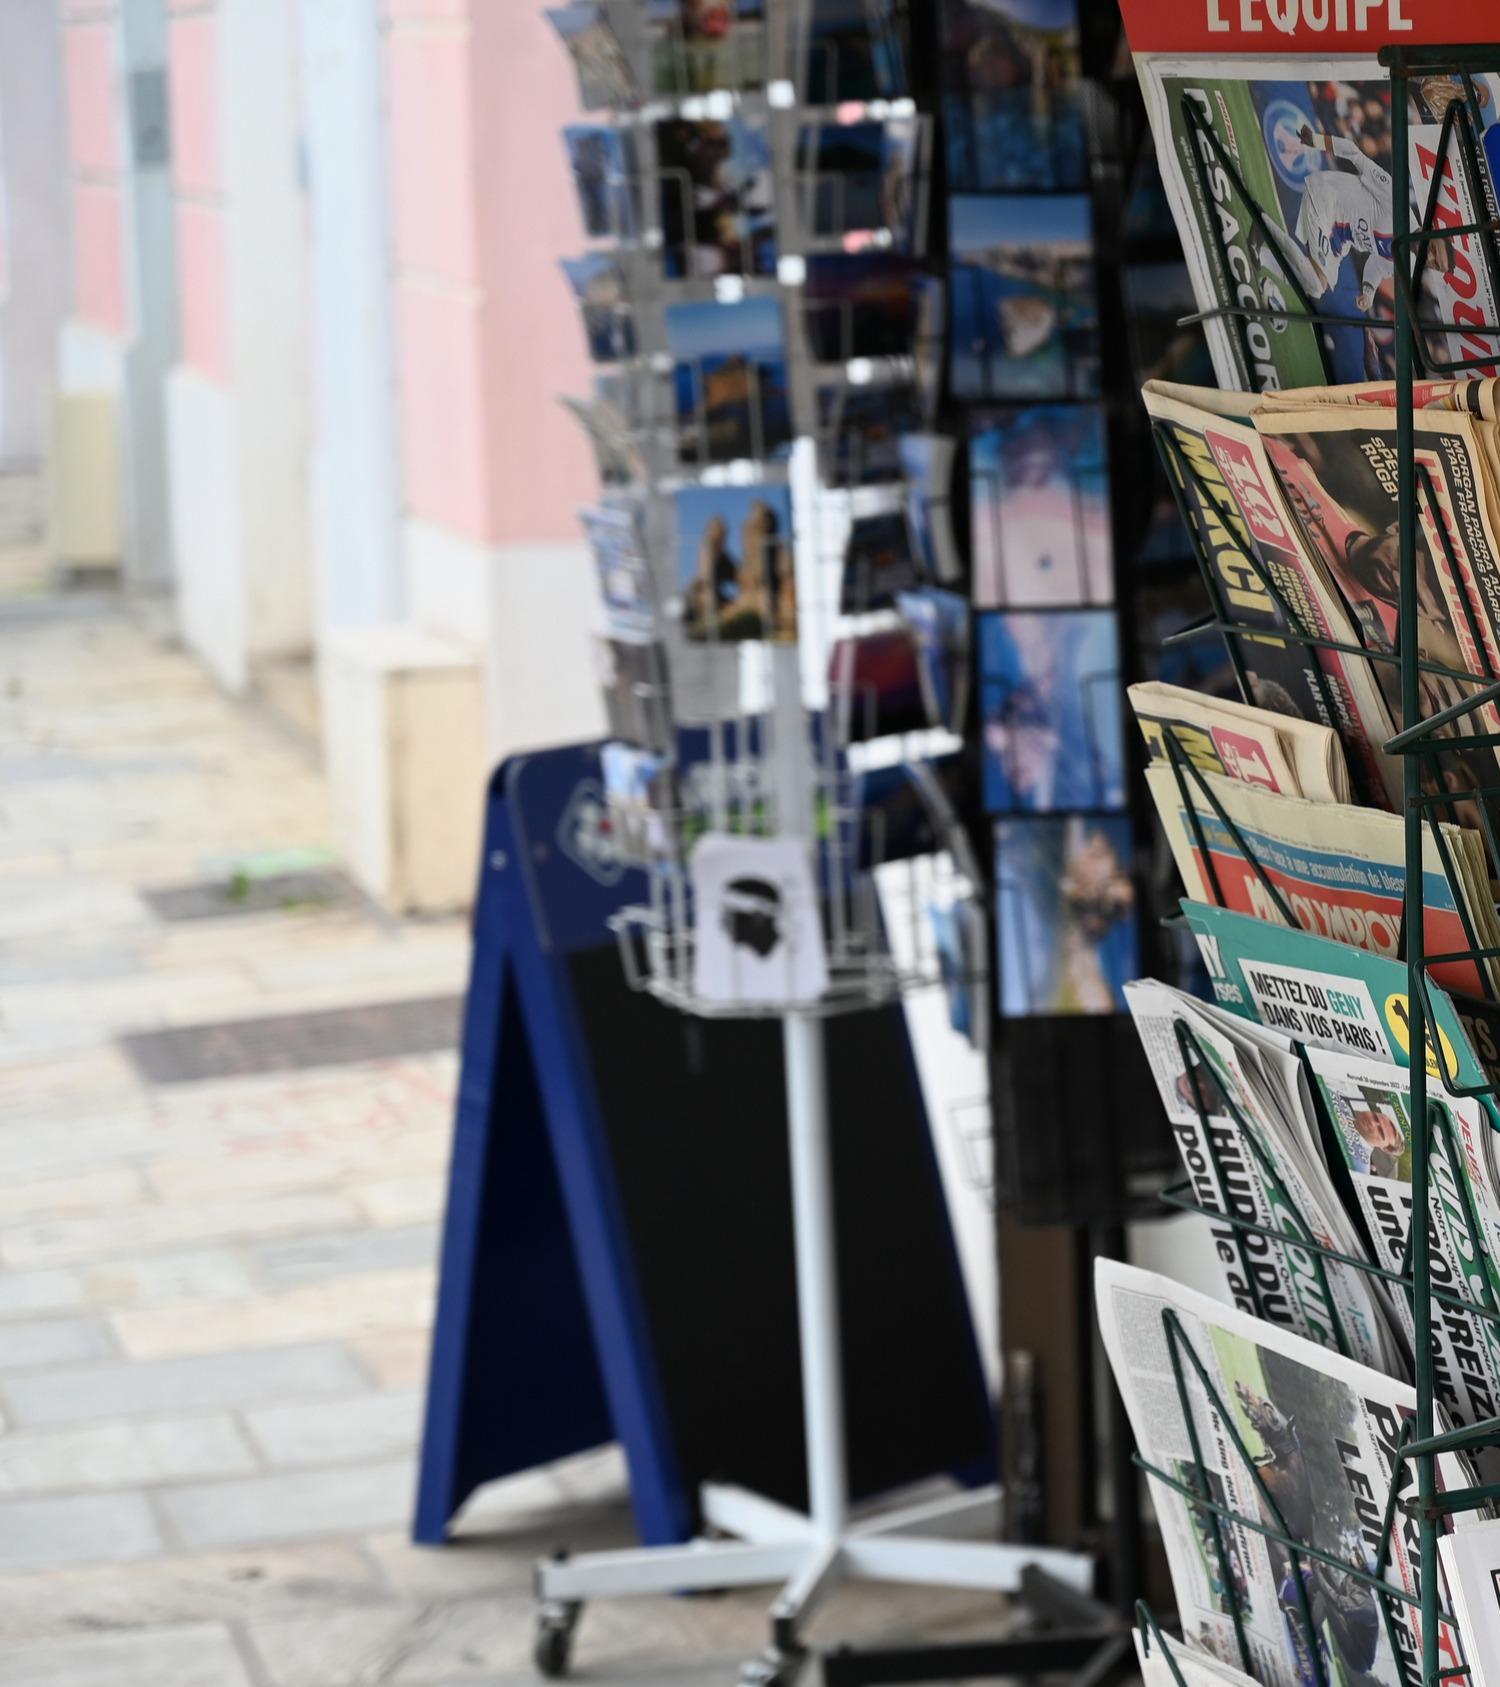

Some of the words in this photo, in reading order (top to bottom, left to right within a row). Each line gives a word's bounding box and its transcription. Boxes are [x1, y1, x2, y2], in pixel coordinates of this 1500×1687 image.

[1482, 179, 1500, 234] religi
[1439, 437, 1464, 487] STADE
[1449, 438, 1477, 511] MORGAN
[1466, 516, 1493, 570] PARRA
[1382, 870, 1407, 892] bless
[1250, 970, 1307, 1004] METTEZ
[1305, 986, 1329, 1012] DU
[1327, 990, 1368, 1020] GENY
[1262, 1001, 1303, 1032] DANS
[1301, 1011, 1333, 1039] VOS
[1335, 1018, 1377, 1052] PARIS
[1432, 1197, 1449, 1241] Notre
[1444, 1243, 1462, 1279] coup
